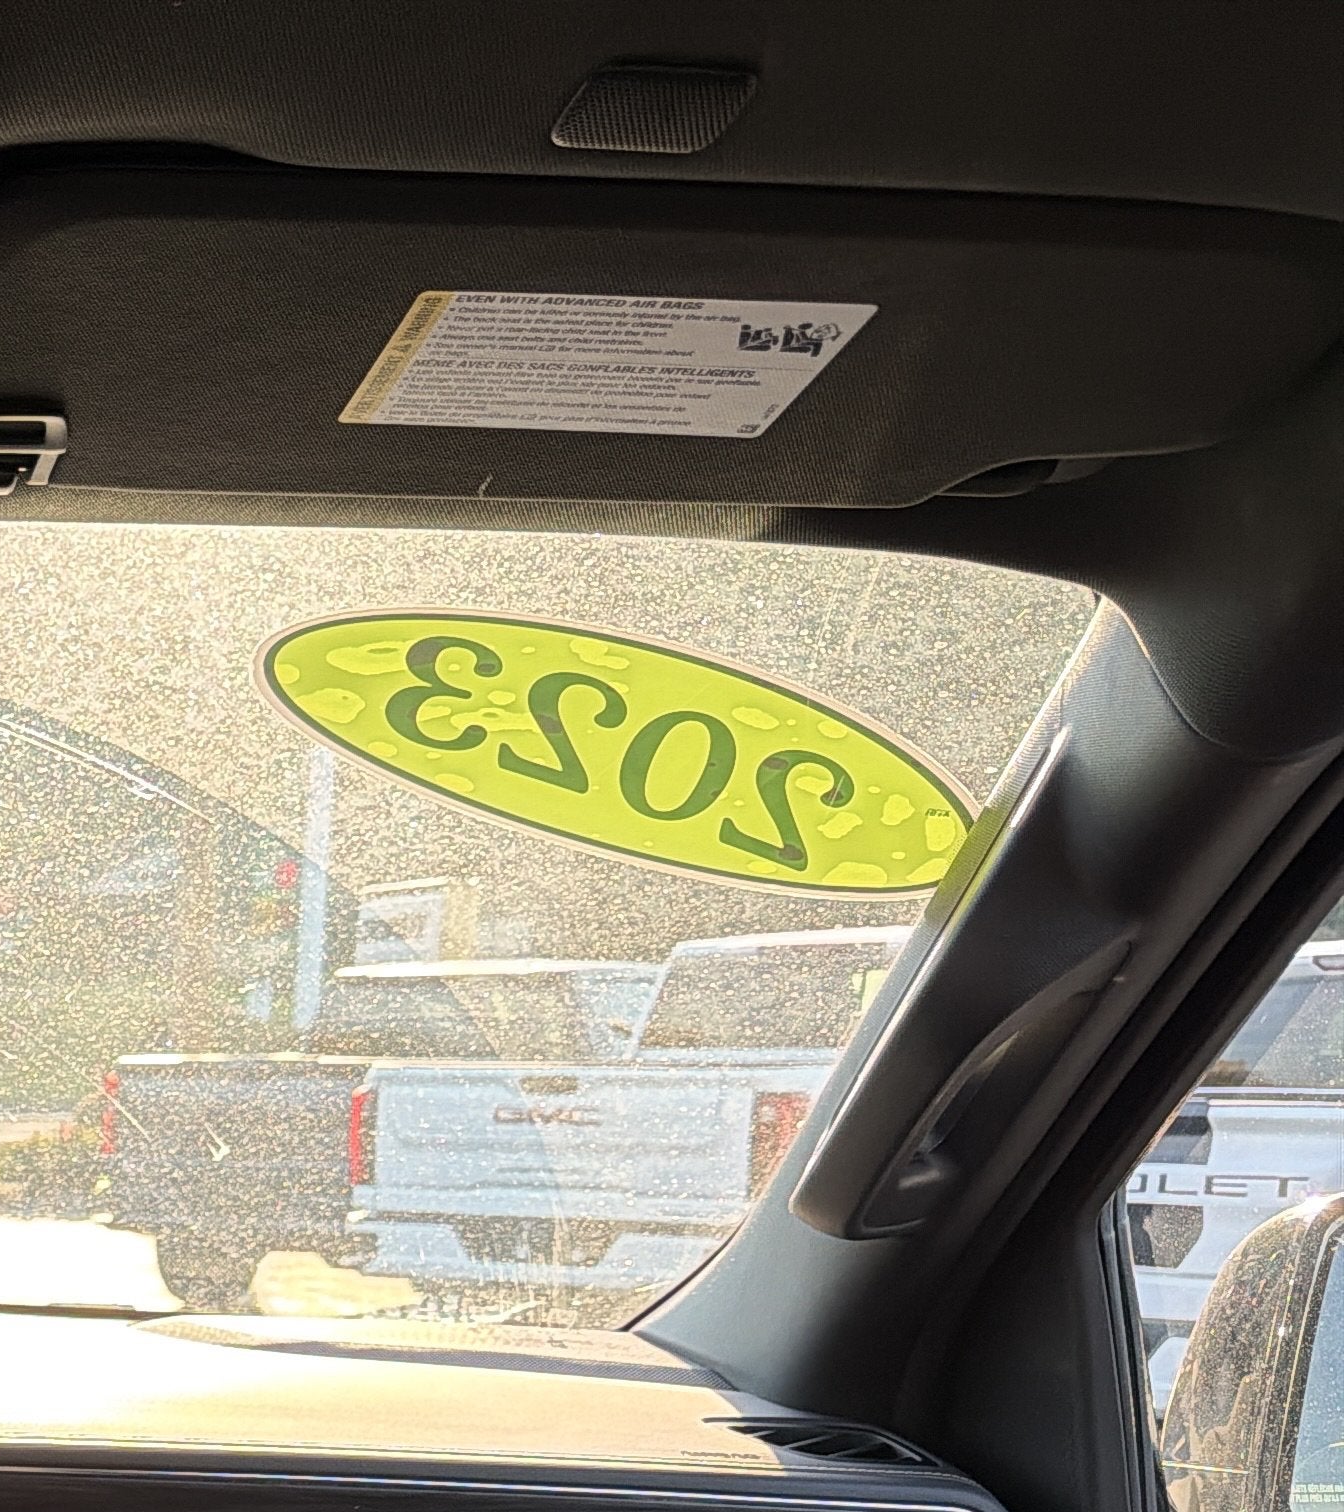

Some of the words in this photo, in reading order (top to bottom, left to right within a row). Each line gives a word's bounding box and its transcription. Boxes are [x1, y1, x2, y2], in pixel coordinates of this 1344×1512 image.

[455, 294, 498, 302] EVEN
[498, 295, 540, 304] WITH
[540, 297, 628, 307] ADVANCED
[627, 300, 658, 308] AIR
[658, 301, 706, 310] BAGS
[455, 359, 496, 369] AVEC
[494, 361, 526, 370] DES
[525, 362, 566, 371] SACS
[564, 364, 658, 375] GONFLABLES
[656, 367, 758, 379] INTELLIGENTS
